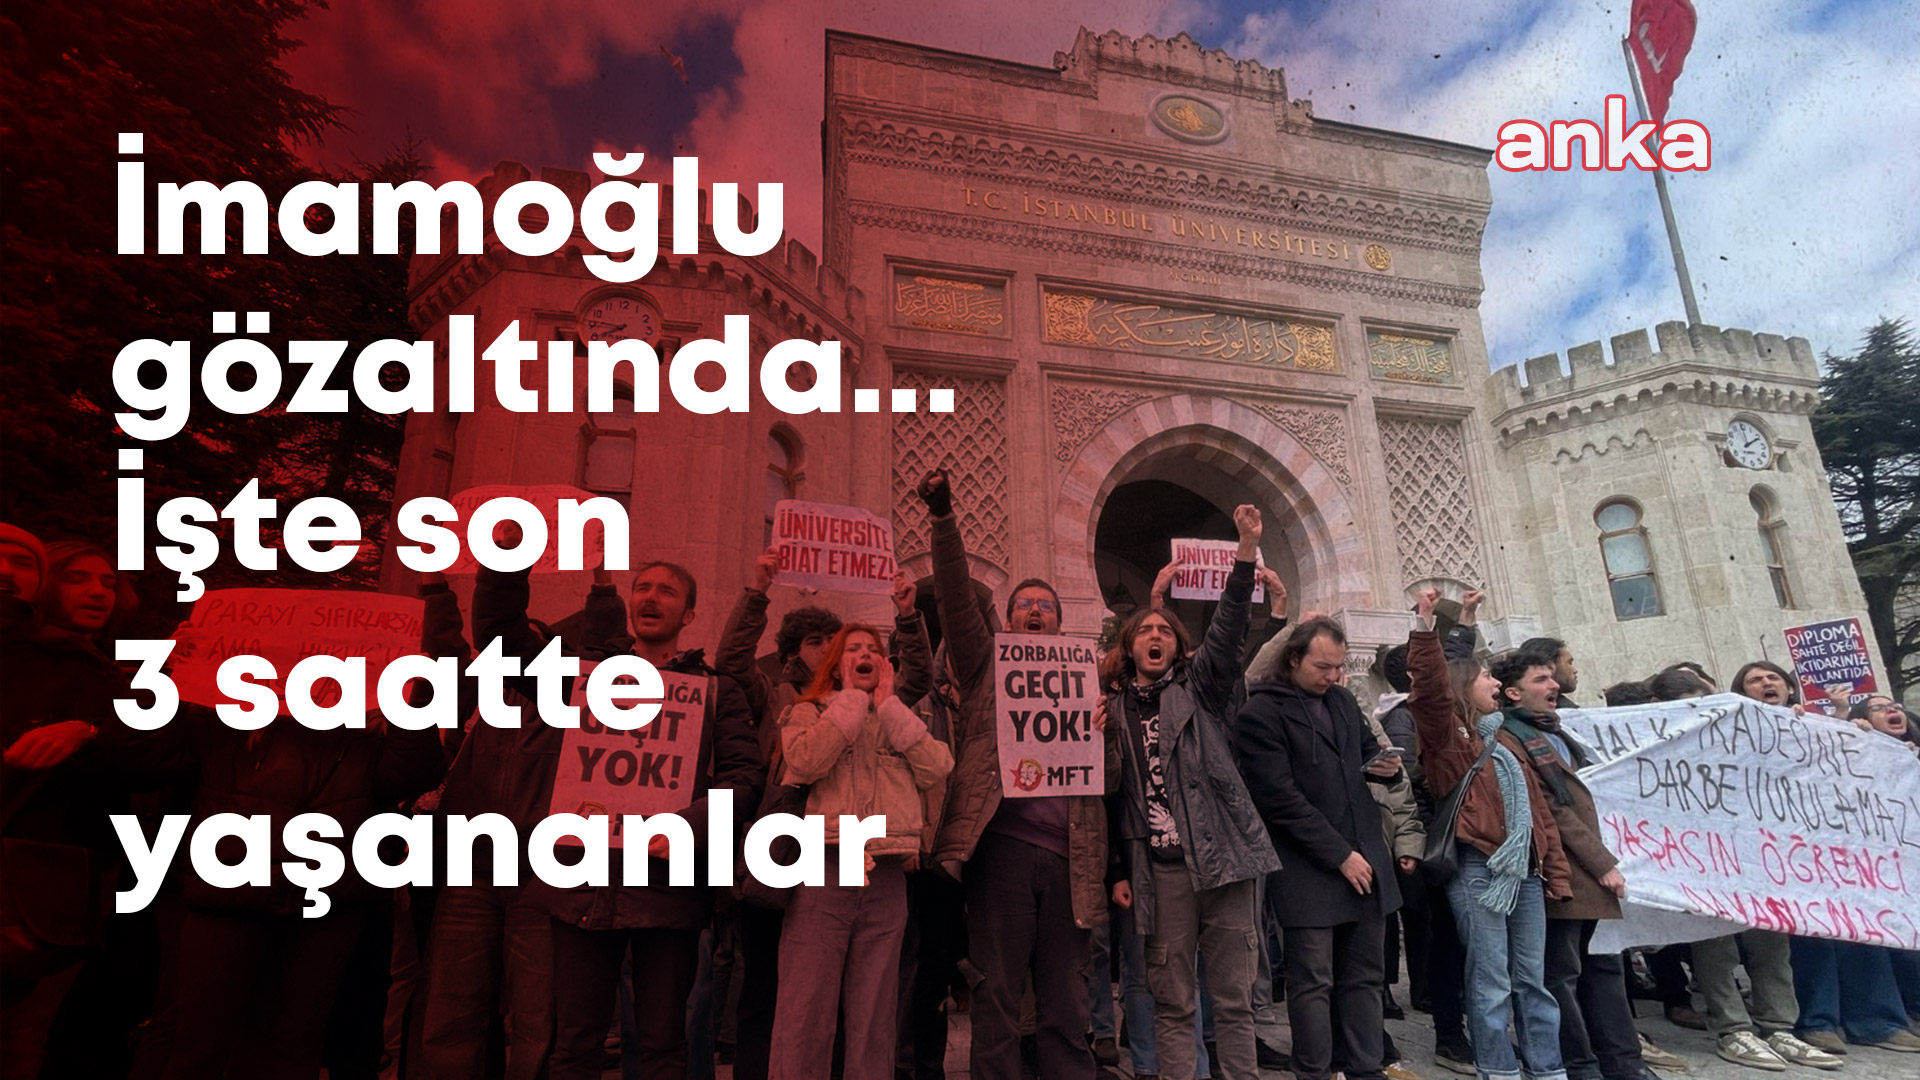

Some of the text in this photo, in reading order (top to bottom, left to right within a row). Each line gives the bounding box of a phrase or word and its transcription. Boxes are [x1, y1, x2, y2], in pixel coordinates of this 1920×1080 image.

[1023, 191, 1153, 232] İSTANBUL
[1170, 213, 1350, 262] ÜNİVERSİTESİ
[779, 508, 892, 553] ÜNİVERSİTE
[778, 541, 894, 582] BİAT ETMEZ!
[999, 644, 1095, 664] ZORBALIĞA
[1786, 623, 1861, 648] DİPLOMA
[1791, 643, 1828, 660] SAHTE
[1004, 664, 1086, 708] GEÇİT
[1008, 710, 1092, 744] YOK!
[577, 745, 683, 791] YOK!
[1047, 765, 1094, 787] MFT
[1636, 756, 1739, 817] DARBE
[1759, 828, 1911, 897] ÖĞRENCİ
